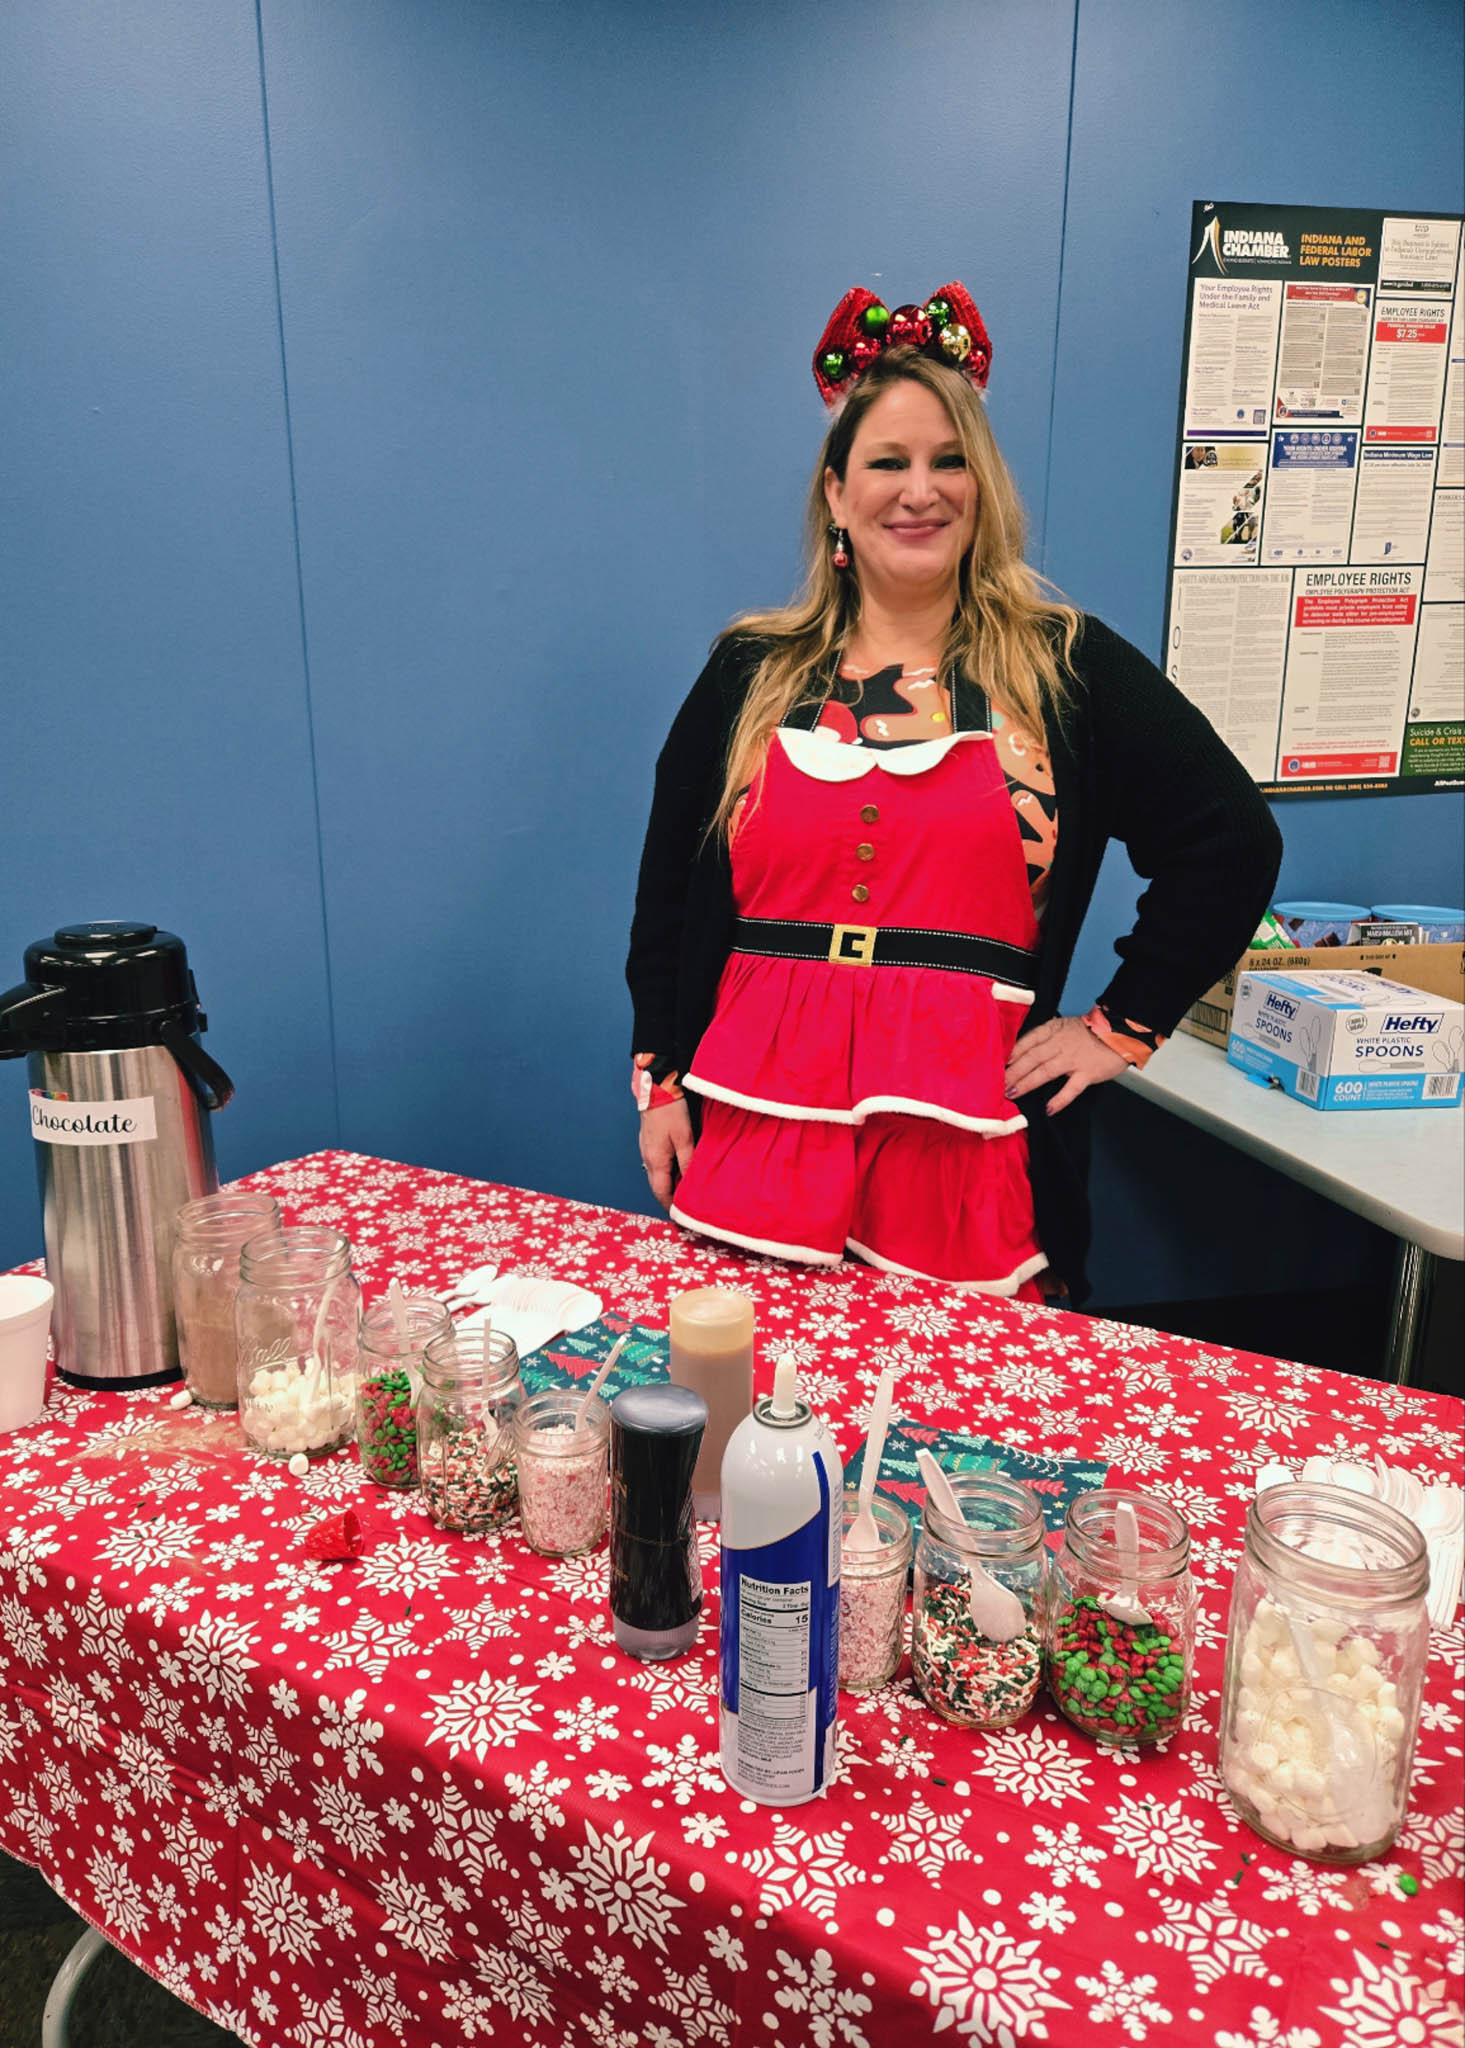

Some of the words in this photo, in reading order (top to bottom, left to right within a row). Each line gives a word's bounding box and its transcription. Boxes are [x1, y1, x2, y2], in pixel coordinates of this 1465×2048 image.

[1224, 230, 1284, 246] INDIANA
[1300, 234, 1342, 244] INDIANA
[1344, 236, 1366, 246] AND
[1222, 242, 1289, 258] CHAMBER
[1300, 244, 1339, 256] FEDERAL
[1341, 246, 1372, 256] LABOR
[1299, 256, 1320, 266] LAW
[1322, 256, 1361, 268] POSTERS
[1216, 284, 1250, 294] Employee
[1252, 284, 1272, 294] Rights
[1234, 294, 1256, 302] Family
[1200, 300, 1226, 308] Medical
[1248, 302, 1260, 310] Act
[1381, 306, 1418, 316] EMPLOYEE
[1420, 308, 1446, 318] RIGHTS
[1396, 328, 1418, 338] $7.25
[1306, 572, 1366, 586] EMPLOYEE
[1370, 572, 1412, 585] RIGHTS
[1410, 728, 1434, 736] Suicide
[1443, 727, 1462, 735] Crisis
[1410, 738, 1430, 746] CALL
[1432, 737, 1445, 745] OR
[1262, 958, 1270, 966] 24
[1267, 994, 1296, 1019] Hefty
[1256, 1018, 1293, 1043] SPOONS
[1385, 1016, 1438, 1033] Hefty
[1355, 1045, 1424, 1058] SPOONS
[1335, 1081, 1363, 1094] 600
[32, 1104, 138, 1133] Chocolate
[742, 1576, 780, 1594] Nutrition
[784, 1586, 808, 1595] Facts
[741, 1609, 772, 1624] Calories
[796, 1614, 808, 1624] 15
